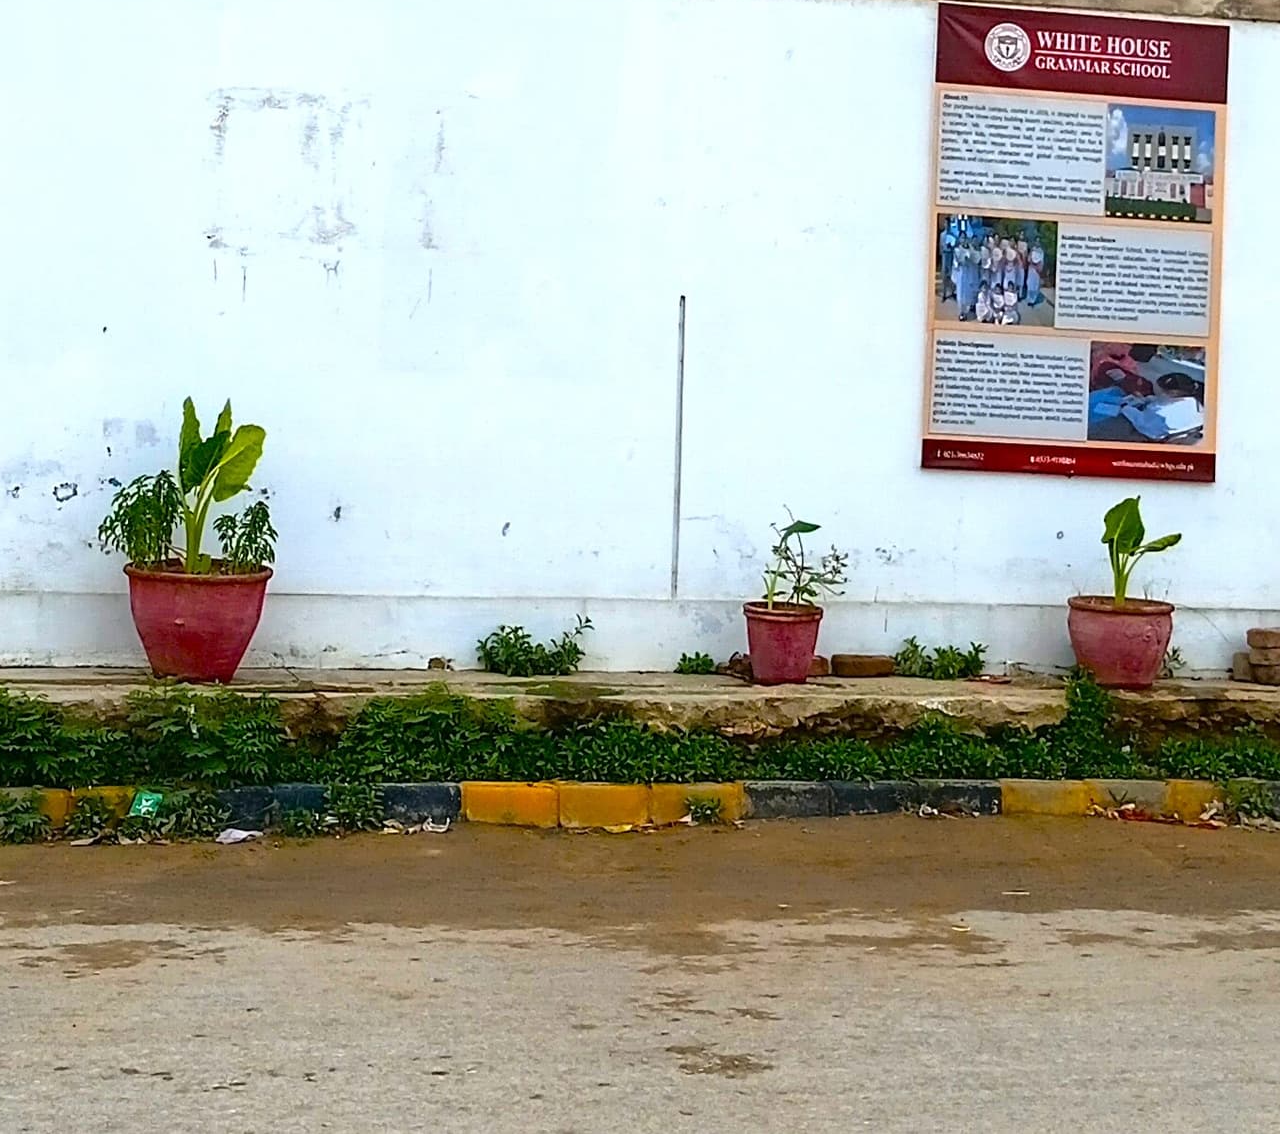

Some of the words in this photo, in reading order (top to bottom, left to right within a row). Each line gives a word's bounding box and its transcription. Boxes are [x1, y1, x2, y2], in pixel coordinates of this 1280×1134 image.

[1036, 30, 1102, 53] WHITE
[1106, 36, 1171, 59] HOUSE
[1034, 55, 1111, 75] GRAMMAR
[1112, 61, 1172, 79] SCHOOL
